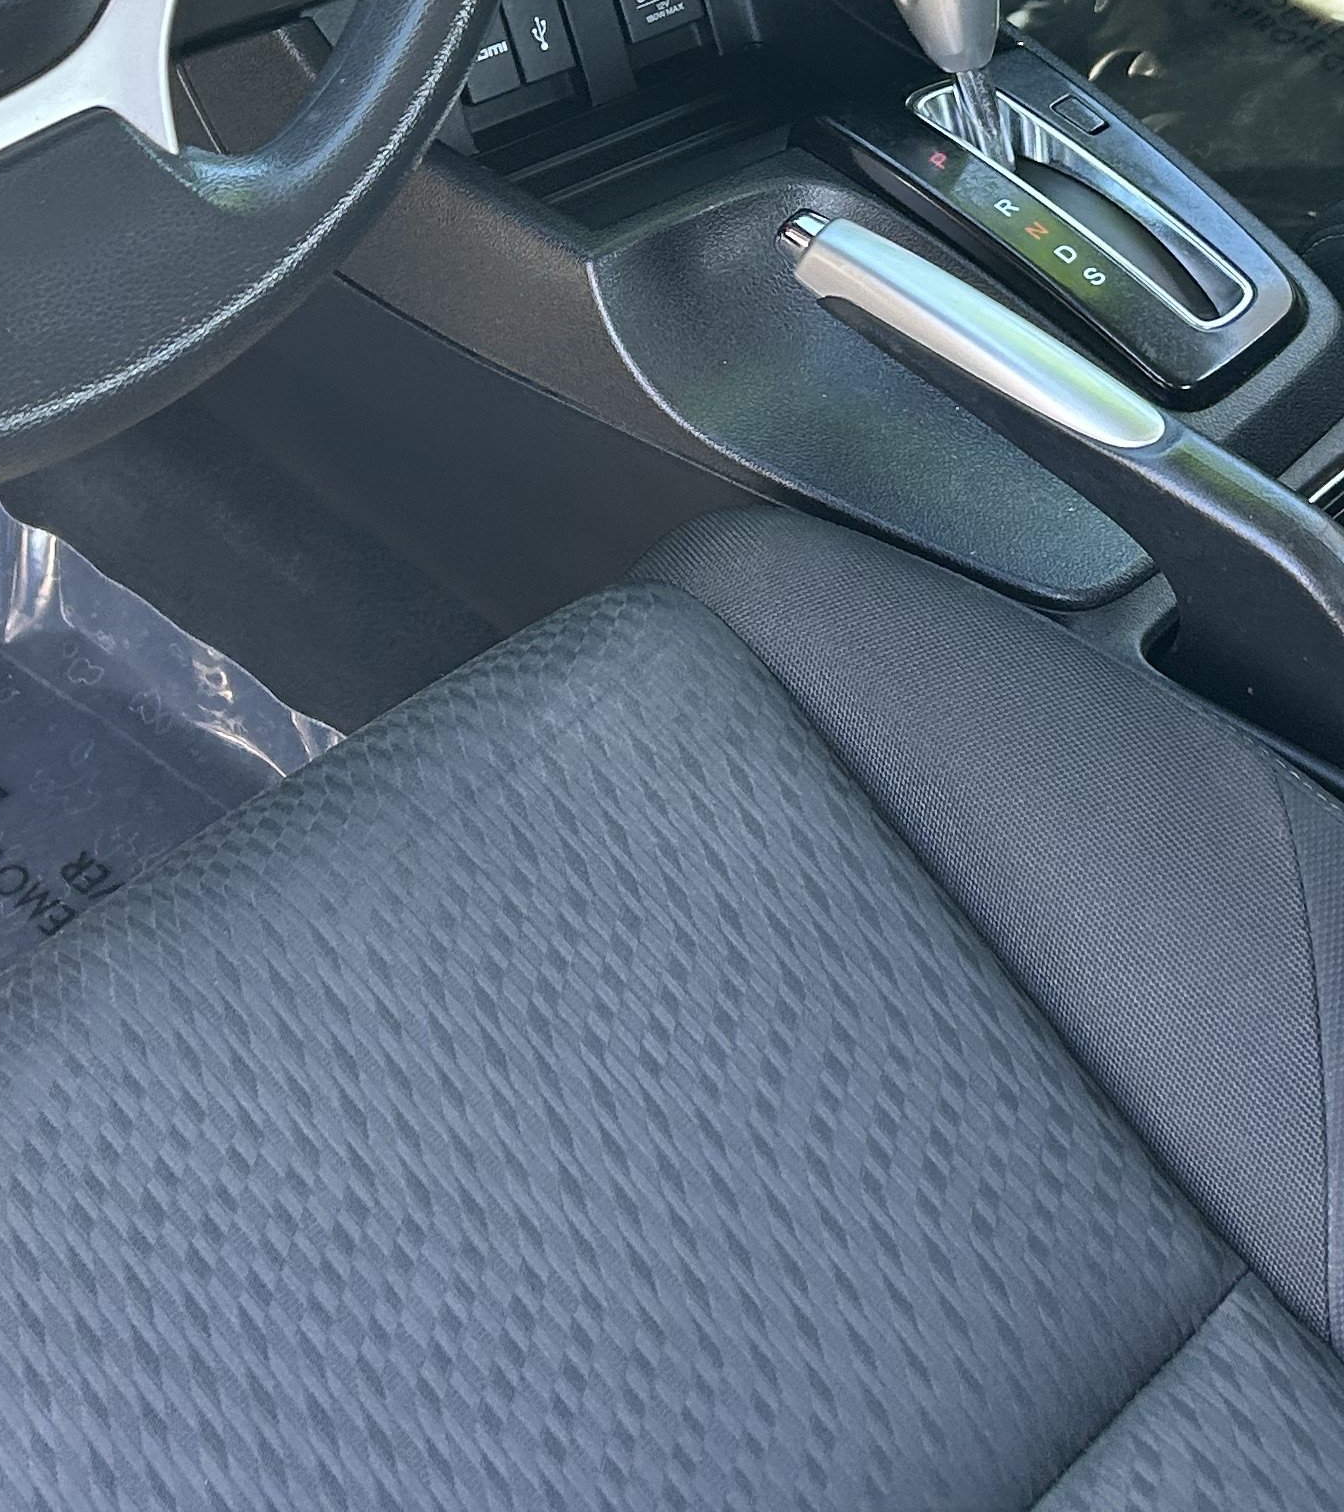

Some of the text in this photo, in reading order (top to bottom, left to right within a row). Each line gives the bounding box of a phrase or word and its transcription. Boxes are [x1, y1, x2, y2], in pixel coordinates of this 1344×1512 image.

[665, 2, 685, 17] MAX
[929, 150, 948, 170] P
[993, 197, 1020, 218] R
[1023, 221, 1051, 241] N
[1053, 244, 1078, 264] D
[1082, 266, 1108, 287] S
